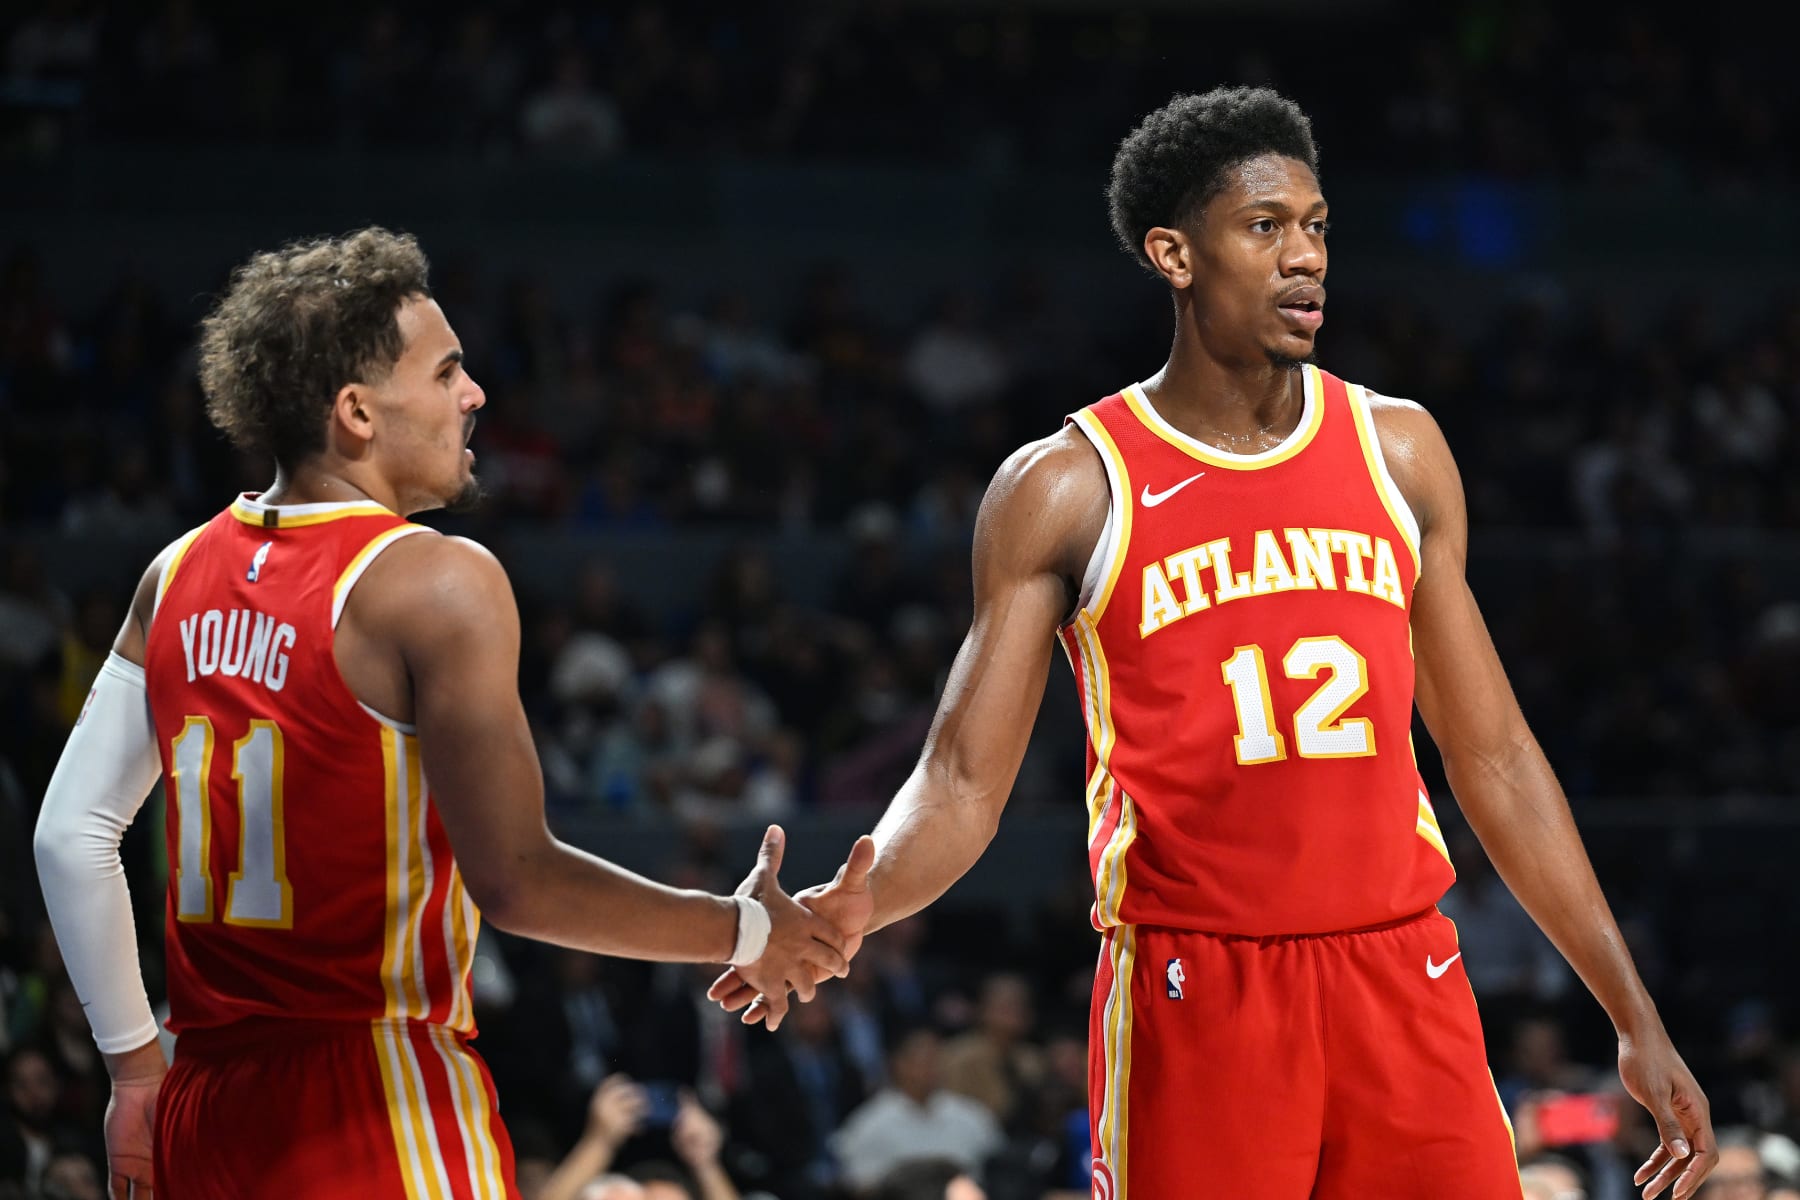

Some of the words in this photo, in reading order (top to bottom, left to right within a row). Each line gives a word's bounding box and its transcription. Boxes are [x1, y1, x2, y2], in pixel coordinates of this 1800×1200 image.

[1140, 527, 1405, 639] ATLANTA
[179, 609, 297, 692] YOUNG
[1221, 635, 1377, 765] 12
[172, 715, 293, 929] 11
